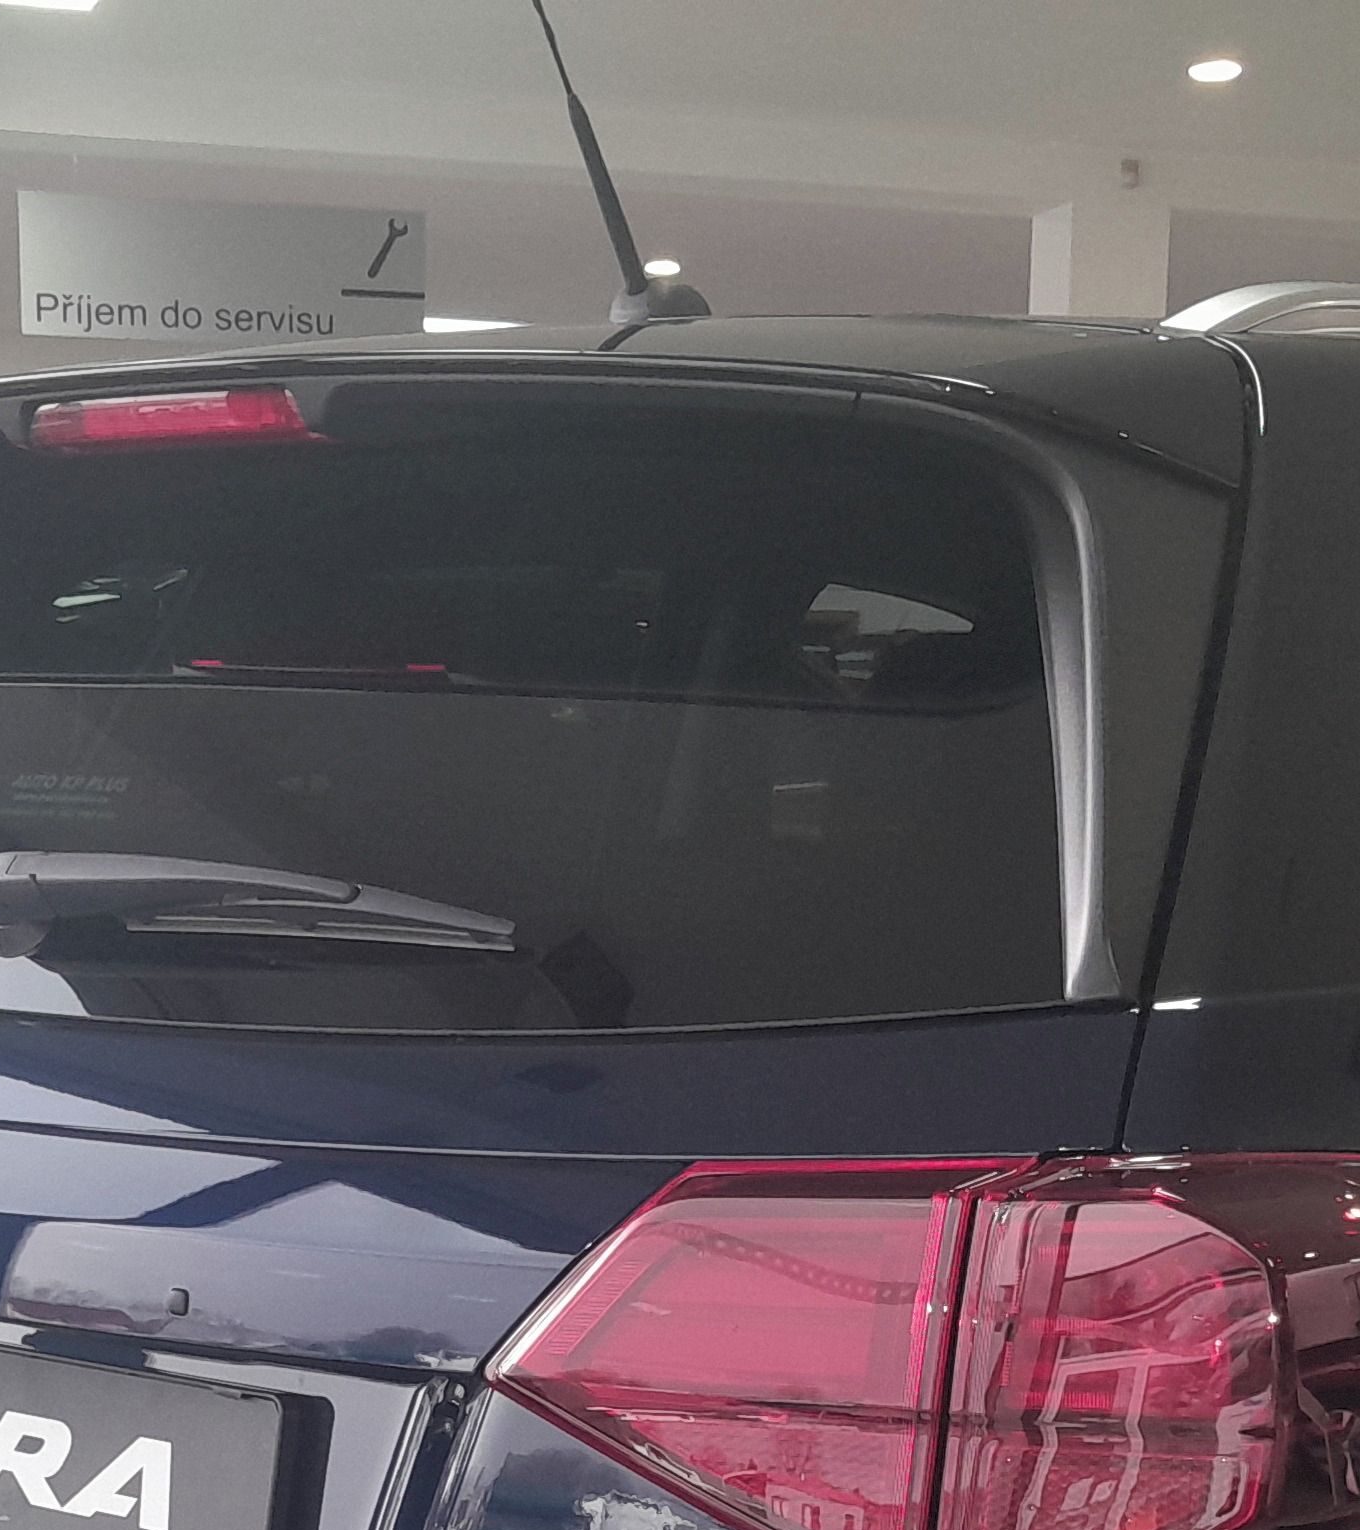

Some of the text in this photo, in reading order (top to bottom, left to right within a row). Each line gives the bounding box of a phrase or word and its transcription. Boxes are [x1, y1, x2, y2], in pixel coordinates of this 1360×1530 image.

[34, 292, 335, 336] Příjem do servisu
